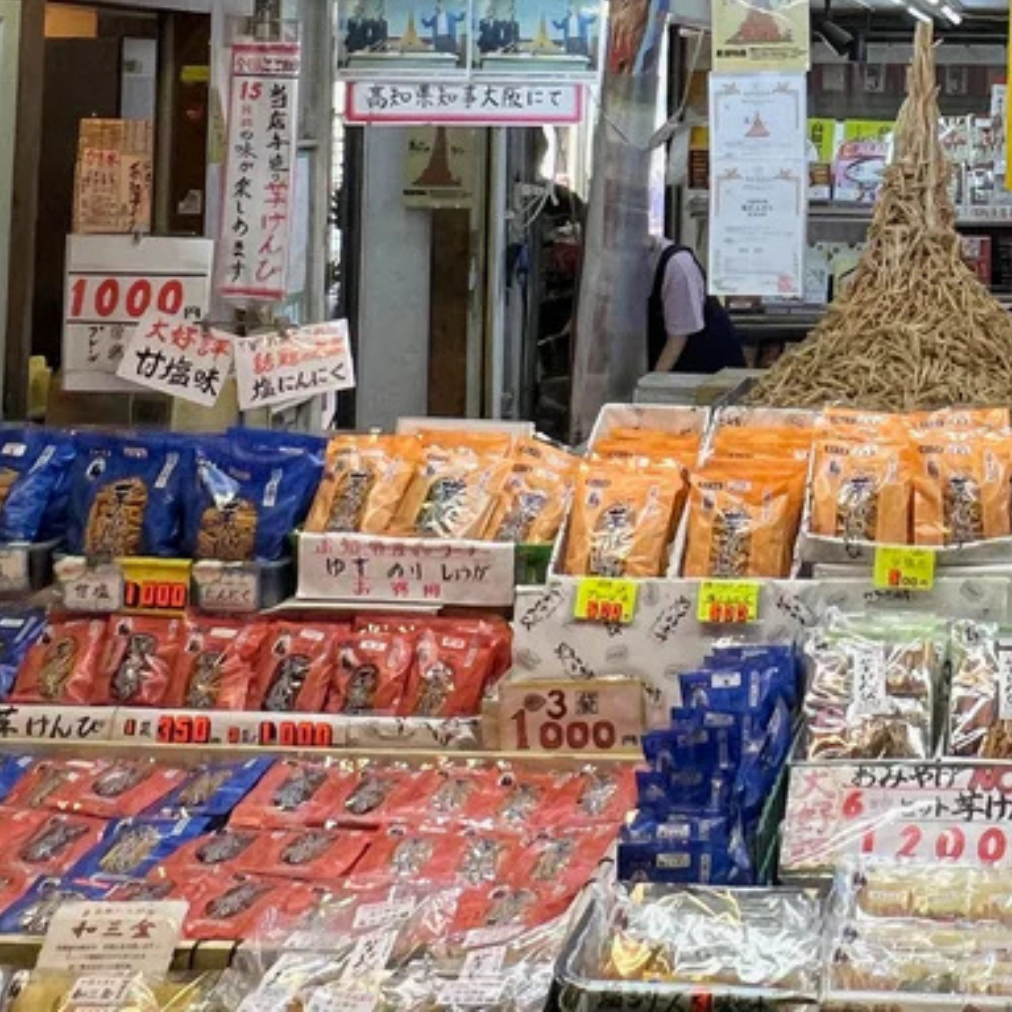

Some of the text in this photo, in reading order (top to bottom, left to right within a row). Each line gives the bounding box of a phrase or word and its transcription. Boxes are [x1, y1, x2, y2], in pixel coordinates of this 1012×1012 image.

[365, 85, 563, 110] 高知県知事大阪にて
[136, 349, 221, 397] 甘塩味
[252, 363, 347, 403] 塩にんにく
